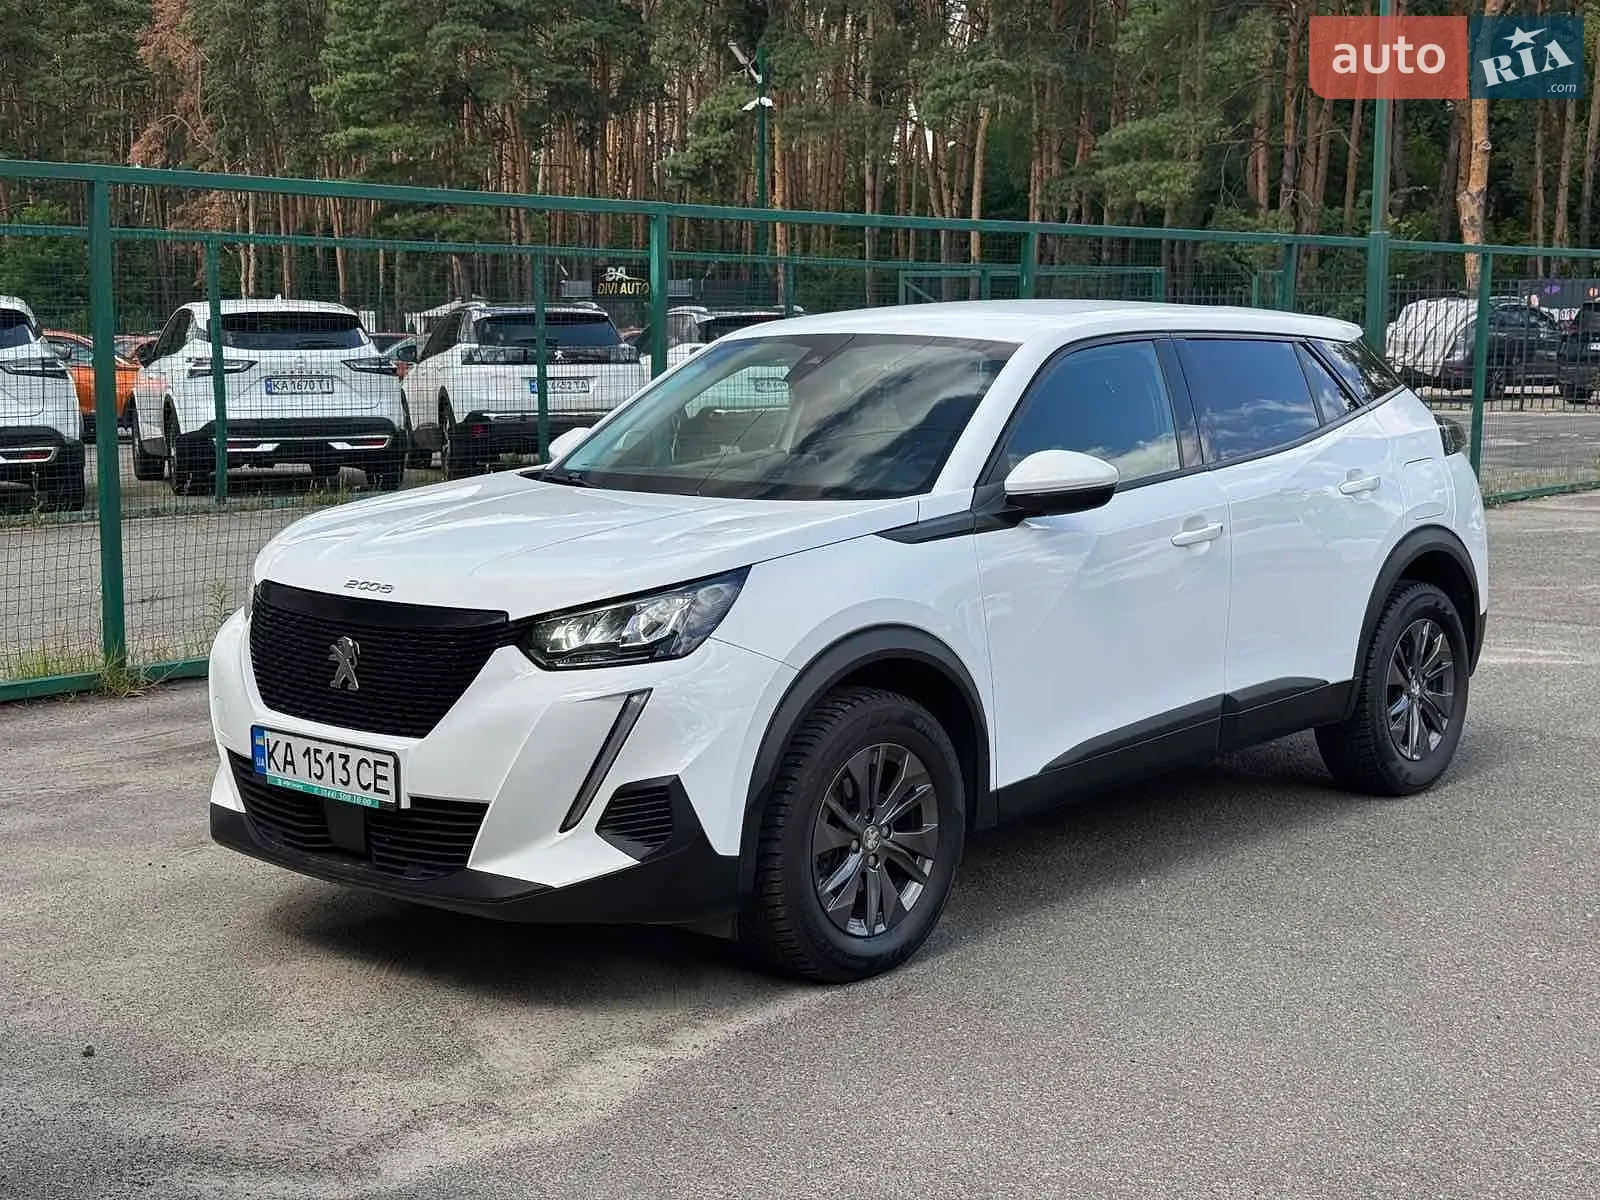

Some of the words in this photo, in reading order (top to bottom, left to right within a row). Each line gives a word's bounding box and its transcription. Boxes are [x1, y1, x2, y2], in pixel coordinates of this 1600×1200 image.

[598, 282, 618, 295] DIVI
[620, 282, 650, 296] AUTO
[272, 380, 289, 391] KA
[266, 738, 297, 775] KA
[303, 746, 350, 786] 1513
[356, 757, 391, 797] CE
